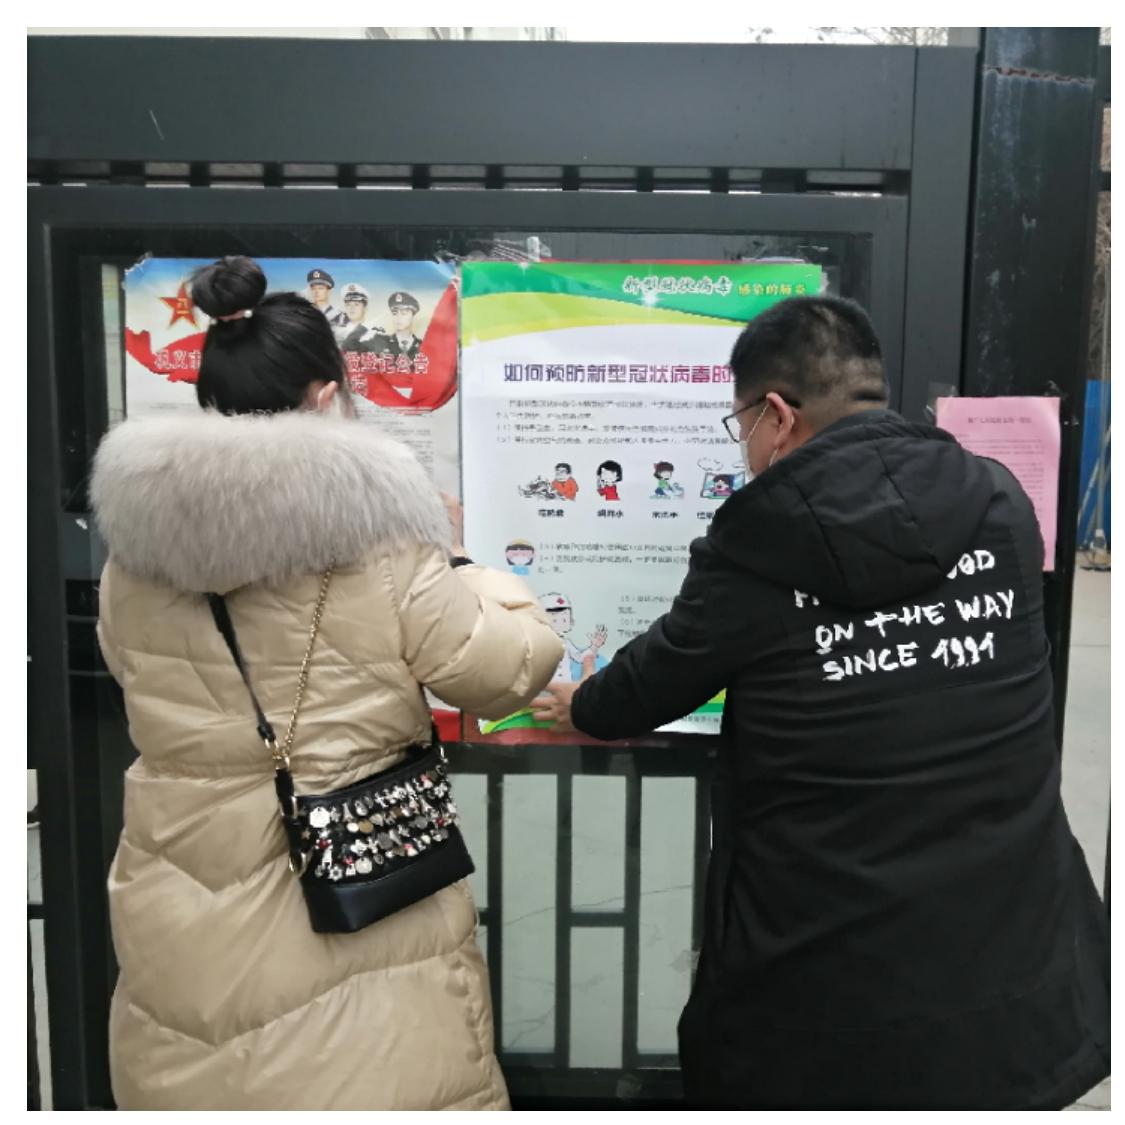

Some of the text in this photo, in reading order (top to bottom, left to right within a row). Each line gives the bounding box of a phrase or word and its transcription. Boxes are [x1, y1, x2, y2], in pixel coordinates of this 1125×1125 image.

[503, 363, 733, 384] 如何预防新型冠状病毒的
[815, 589, 1014, 654] ON THE WAY
[822, 641, 919, 681] SINCE
